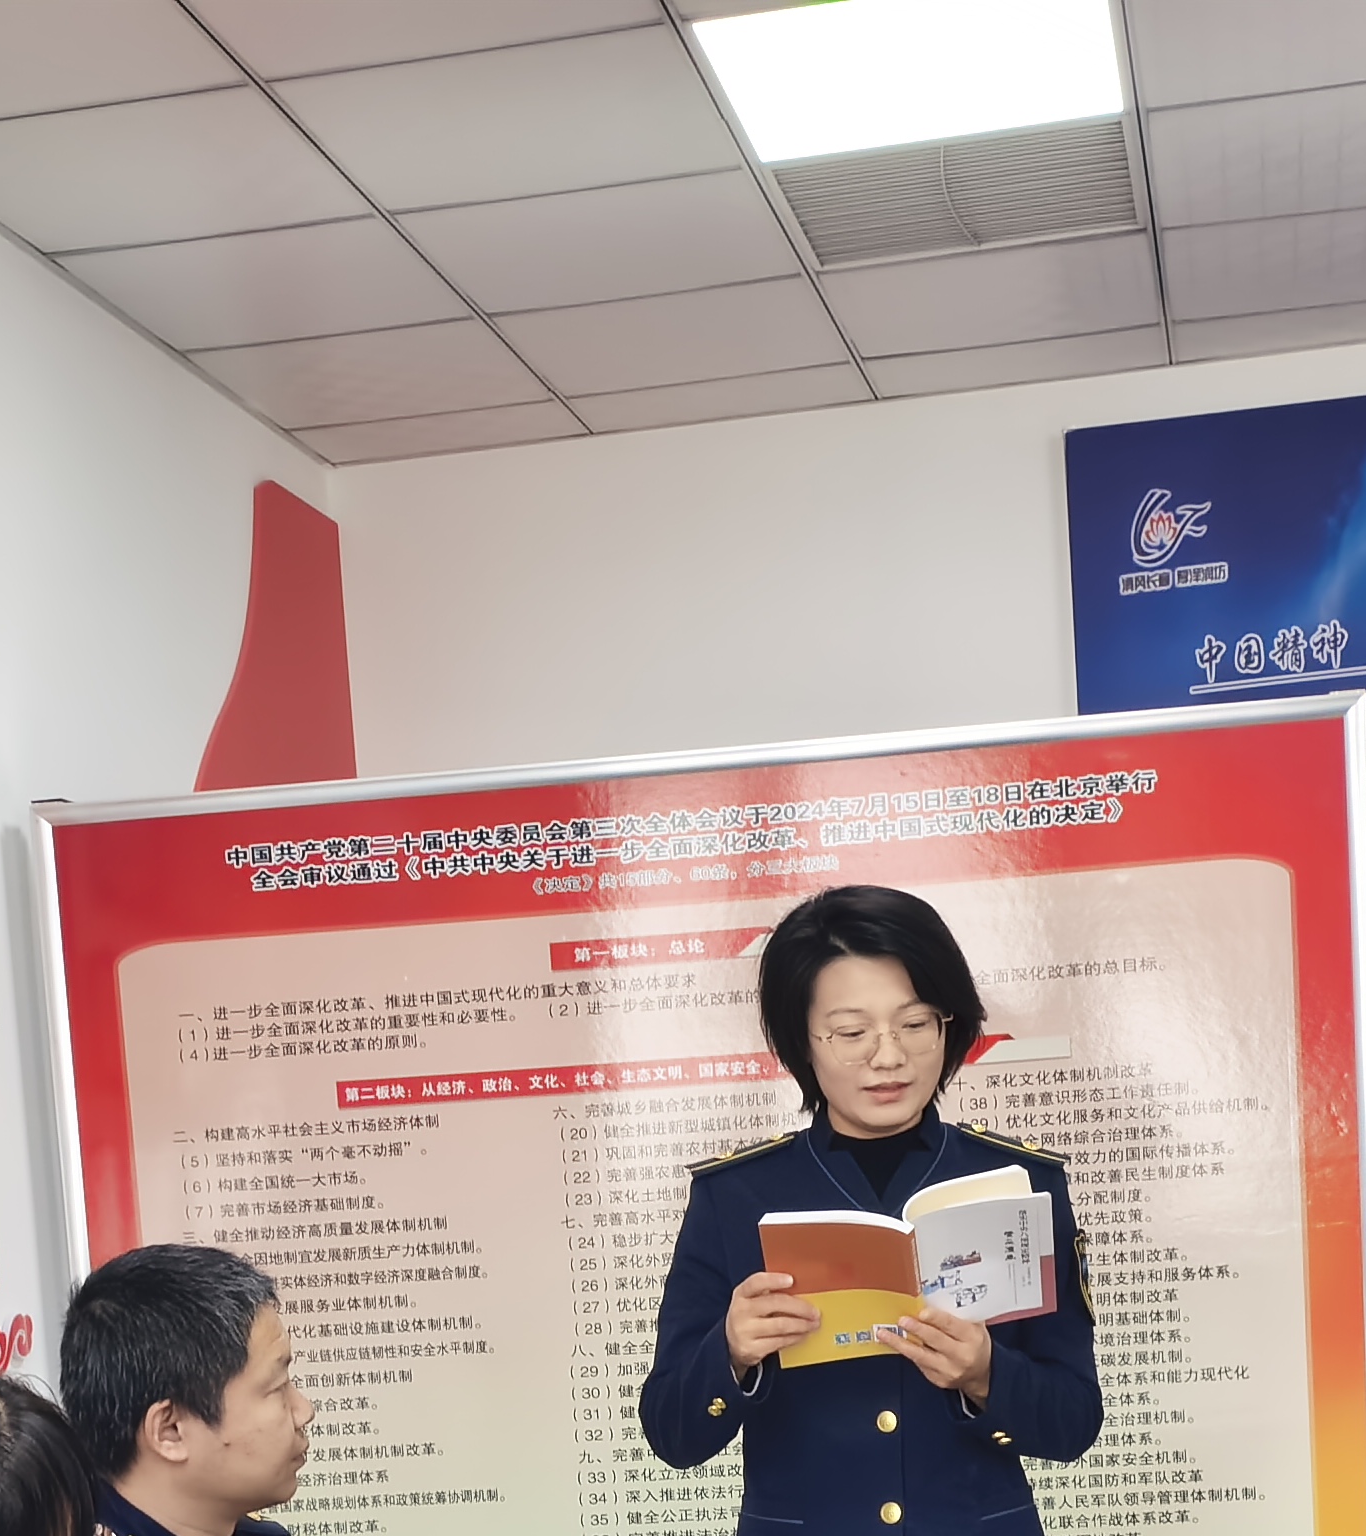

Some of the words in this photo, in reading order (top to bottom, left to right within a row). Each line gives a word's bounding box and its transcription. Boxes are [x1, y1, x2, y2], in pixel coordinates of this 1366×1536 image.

[1194, 619, 1349, 684] 中国精神
[225, 768, 1157, 868] 中国共产党第二十届中央委员会第三次全体会议于2024年7月15日至18日在北京举行
[251, 798, 1124, 892] 全会审议通过《中共中央关于进一步全面深化改革、推进中国式现代化的决定》
[345, 1059, 789, 1103] 第二板块：从经济、政治、文化、社会、生态文明、国家安全、
[173, 1114, 439, 1144] 二、构建高水平社会主义市场经济体制
[1010, 1125, 1183, 1150] 全网络综合治理体系。
[183, 1171, 367, 1194] （6）构建全国统一大市场。
[563, 1163, 691, 1185] （22）完善强农惠
[185, 1195, 384, 1219] （7）完善市场经济基础制度。
[1070, 1188, 1152, 1207] 分配制度。
[1077, 1208, 1152, 1227] 优先政策。
[183, 1215, 447, 1245] 三、健全推动经济高质量发展体制机制
[568, 1230, 678, 1251] （24）稳步扩大
[287, 1316, 481, 1339] 代化基础设施建设体制机制。
[1093, 1329, 1191, 1348] 境治理体系。
[291, 1369, 413, 1389] 全面创新体制机制
[1100, 1364, 1250, 1388] 全体系和能力现代化
[1102, 1391, 1160, 1409] 全体系。
[1104, 1409, 1194, 1428] 全治理机制。
[297, 1470, 389, 1488] 经济治理体系
[287, 1520, 388, 1536] 财税体制改革。
[1043, 1509, 1199, 1530] 化联合作战体系改革。
